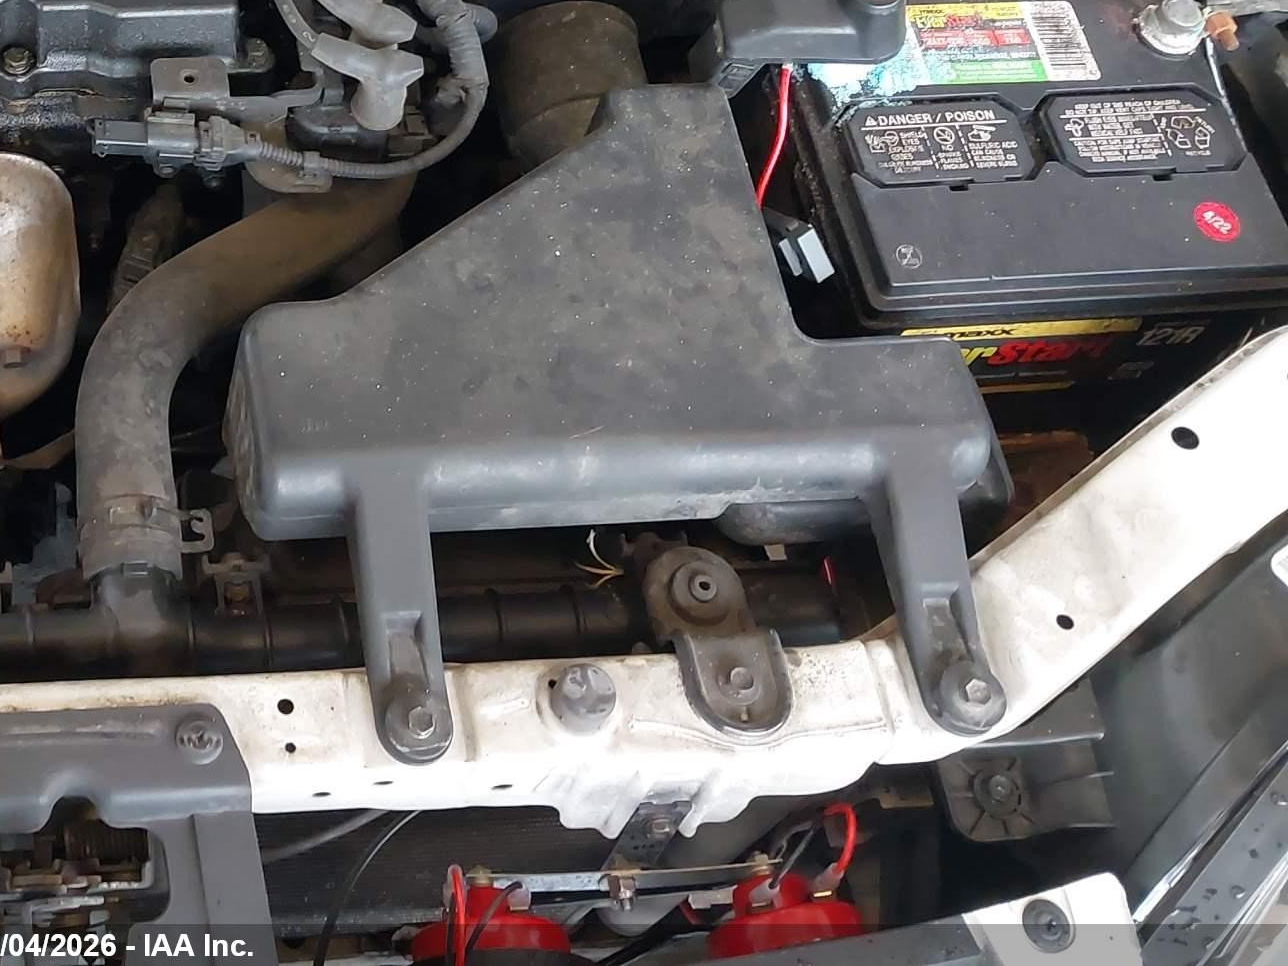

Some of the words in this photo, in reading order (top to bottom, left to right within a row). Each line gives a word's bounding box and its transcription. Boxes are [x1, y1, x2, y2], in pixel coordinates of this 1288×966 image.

[878, 113, 933, 126] DANGER
[935, 111, 942, 123] /
[945, 109, 995, 123] POISON
[1202, 210, 1232, 235] 4/22
